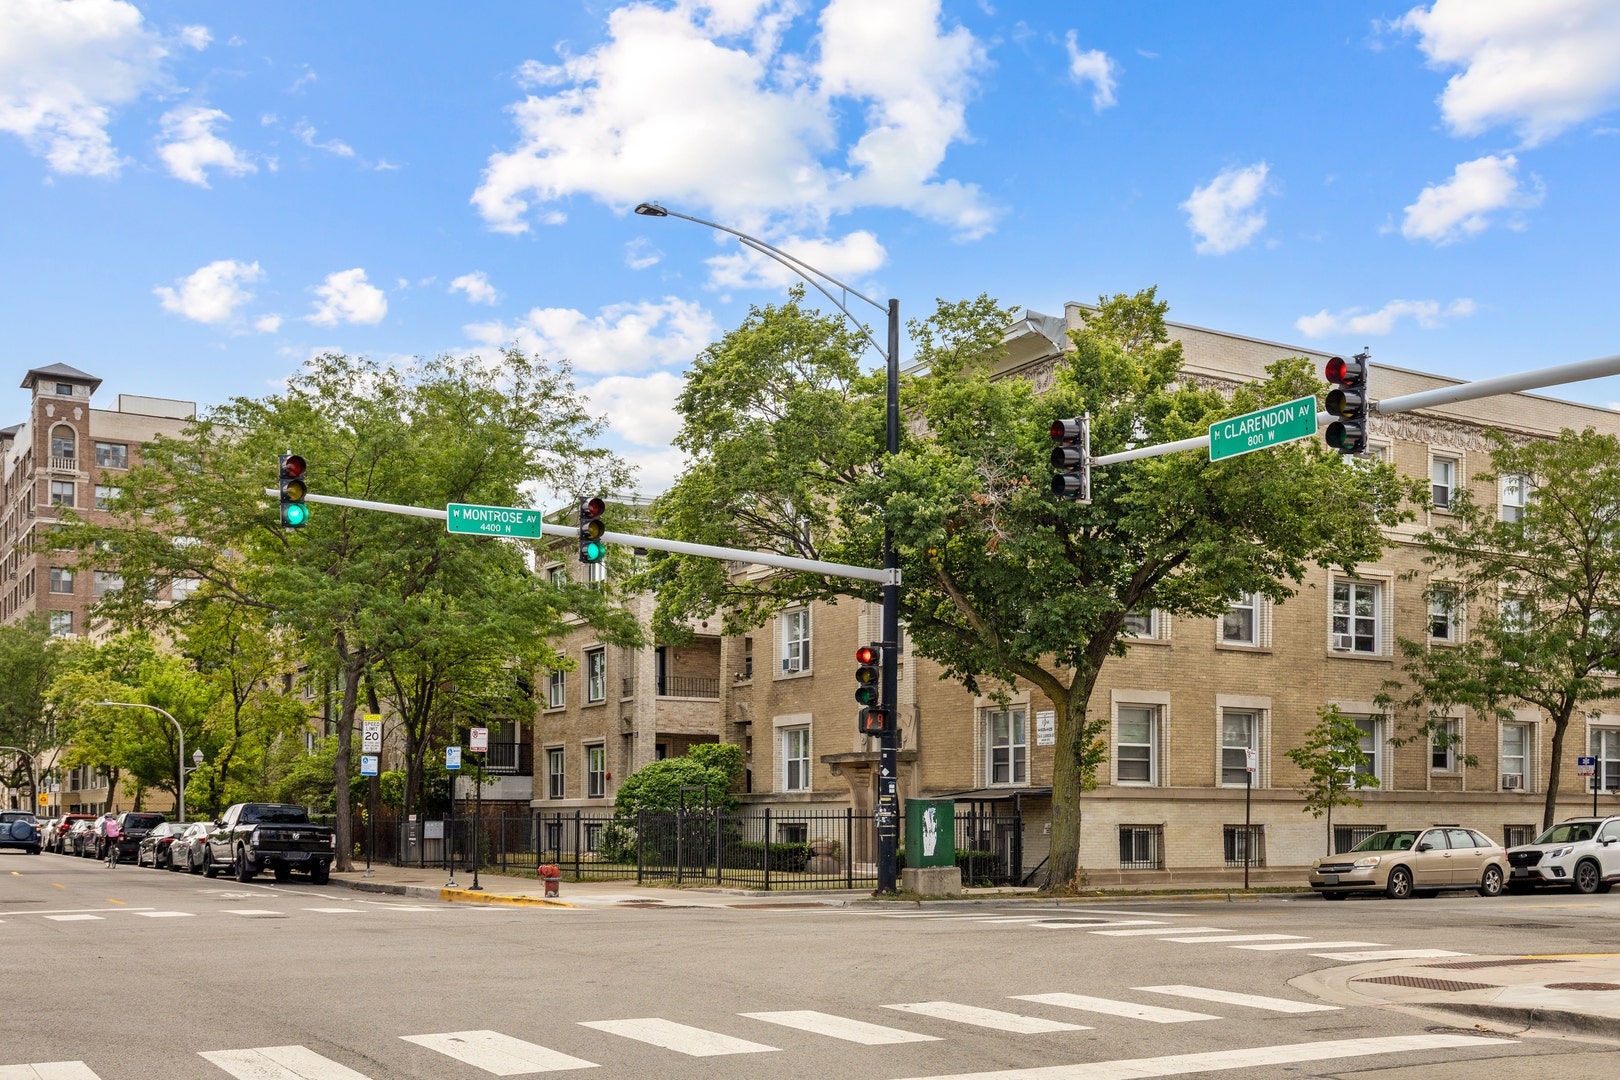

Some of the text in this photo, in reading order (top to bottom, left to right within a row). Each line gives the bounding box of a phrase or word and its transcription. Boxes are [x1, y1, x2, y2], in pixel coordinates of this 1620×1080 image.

[1224, 407, 1294, 439] CLARENDON
[1298, 404, 1310, 417] AV
[1247, 430, 1275, 446] 800 W
[453, 508, 537, 524] W MONTROSE AV
[480, 523, 501, 532] 4400
[877, 713, 883, 729] 9
[365, 732, 379, 741] 20
